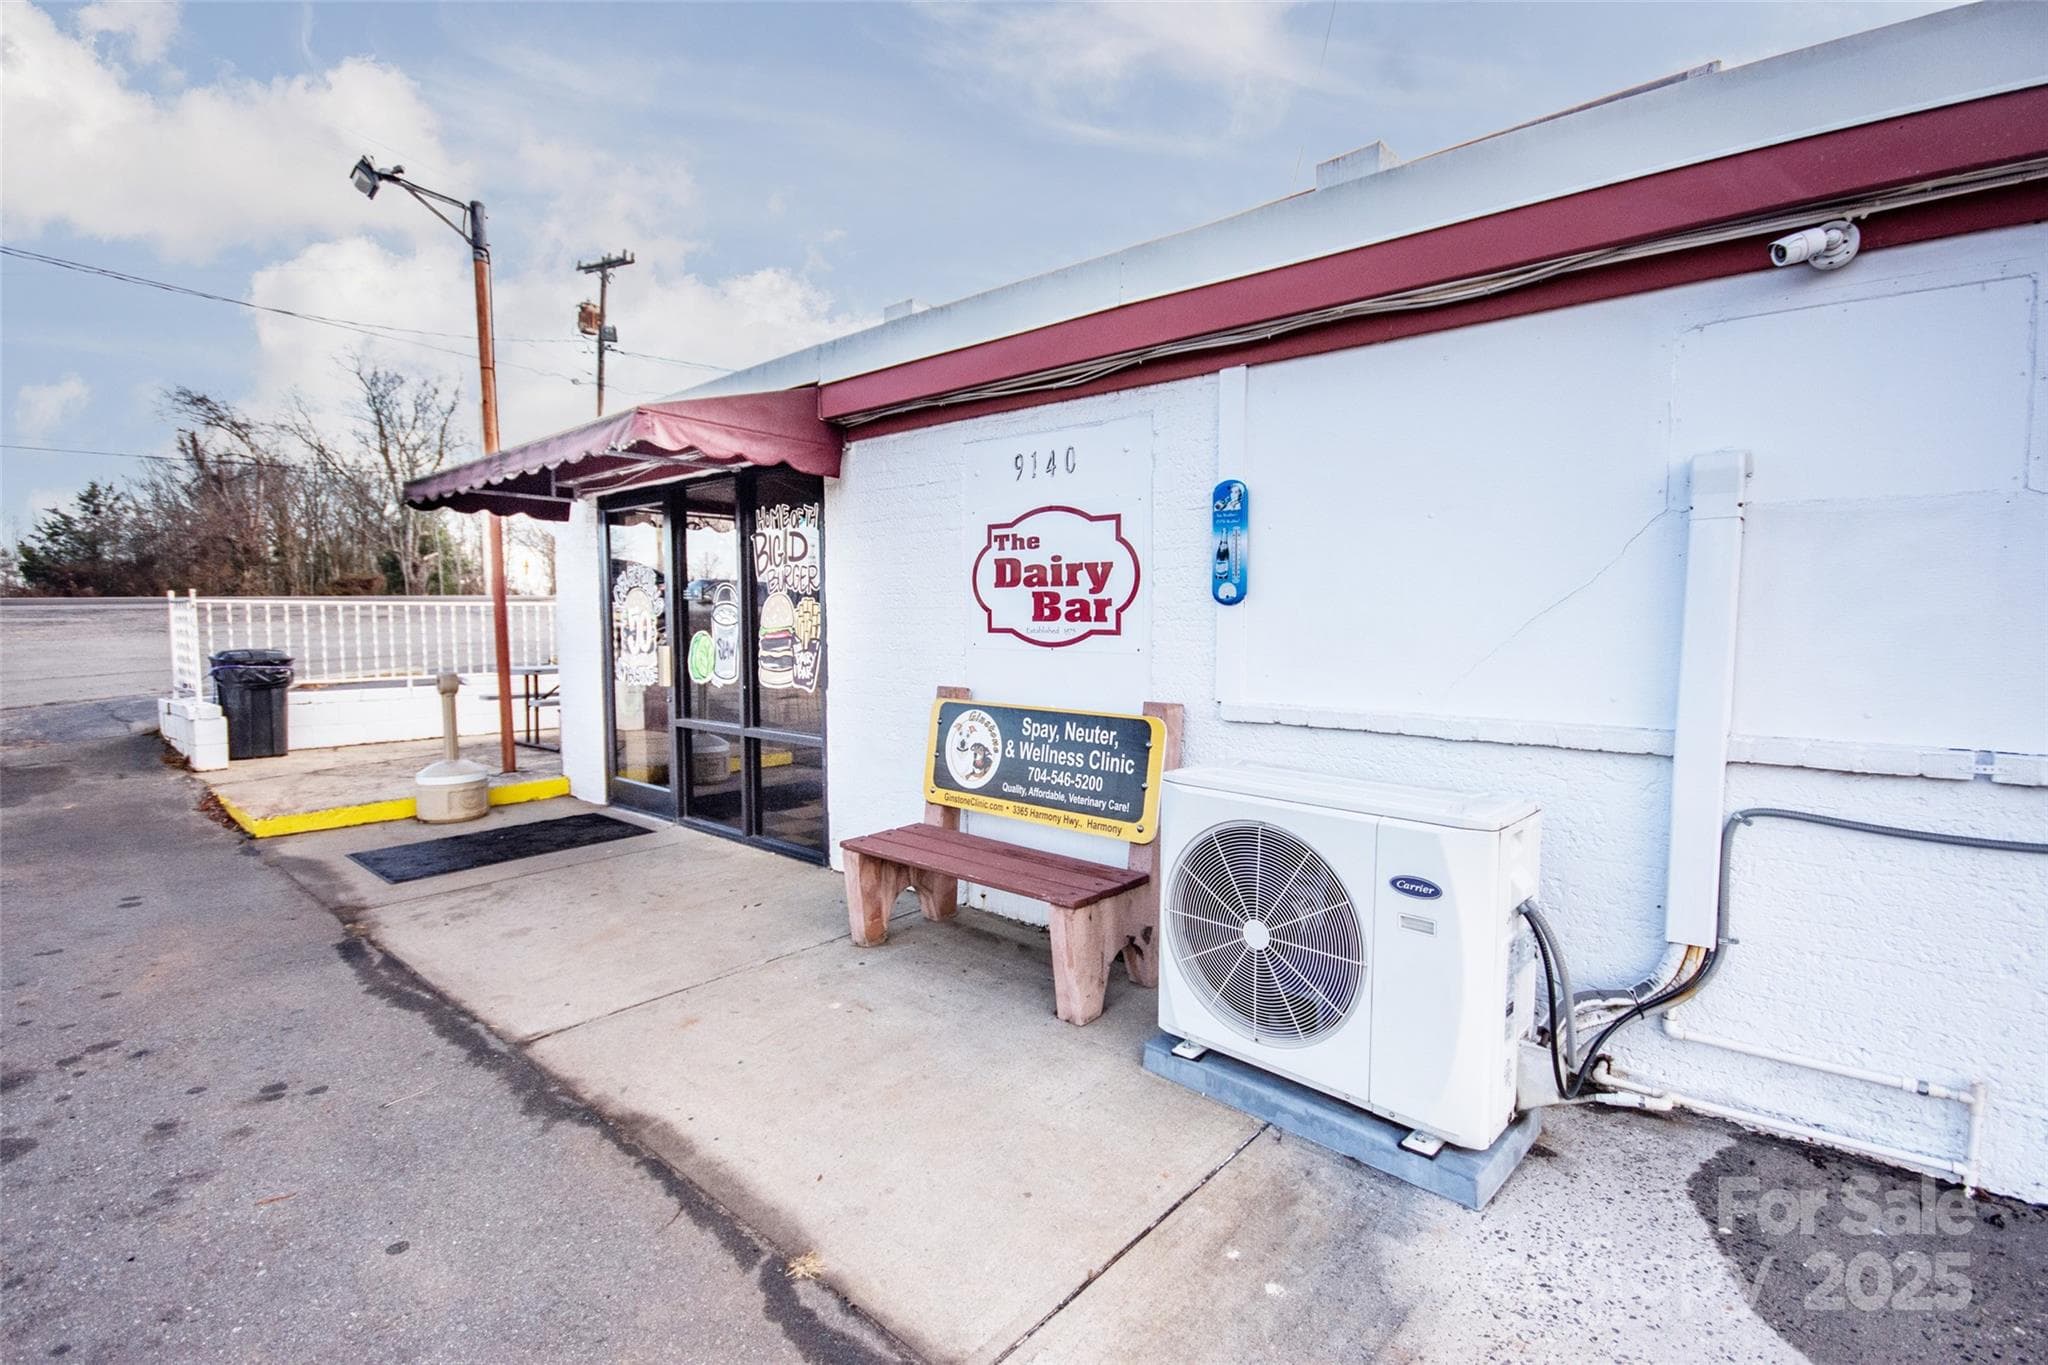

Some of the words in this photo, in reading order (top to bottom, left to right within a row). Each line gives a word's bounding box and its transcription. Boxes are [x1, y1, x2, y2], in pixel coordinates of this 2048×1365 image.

[1014, 446, 1077, 481] 9140
[752, 532, 784, 577] BIG
[993, 533, 1041, 551] The
[768, 565, 820, 594] BURGER
[993, 555, 1114, 595] Dairy
[1032, 591, 1113, 623] Bar
[1021, 717, 1060, 743] Spay,
[1064, 721, 1119, 749] Neuter,
[1005, 740, 1015, 759] &
[1019, 741, 1085, 766] Wellness
[1088, 750, 1136, 775] Clinic
[1027, 766, 1104, 792] 704-546-5200
[1002, 782, 1028, 797] Quality,
[1028, 786, 1067, 803] Affordable,
[1068, 793, 1110, 811] Veterinary
[1108, 799, 1131, 813] Care!
[1012, 805, 1029, 817] 3365
[1029, 808, 1061, 825] Harmony
[1086, 820, 1122, 836] Harmony
[1396, 879, 1435, 895] Carrier
